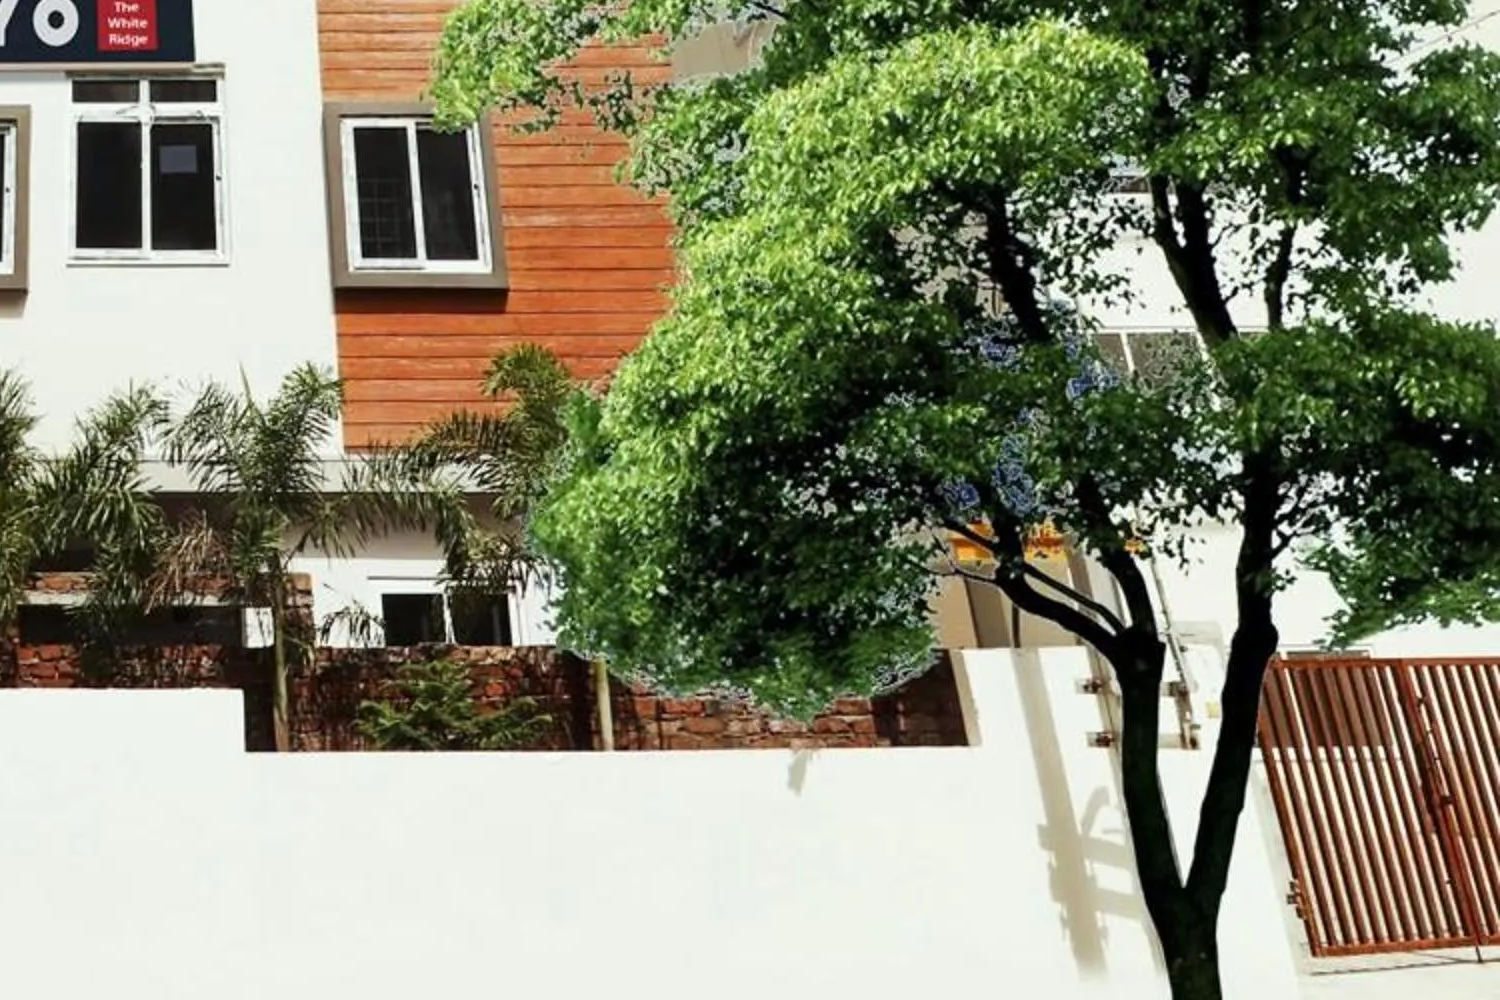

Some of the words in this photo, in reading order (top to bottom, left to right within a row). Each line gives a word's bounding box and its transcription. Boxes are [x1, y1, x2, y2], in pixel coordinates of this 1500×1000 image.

[114, 1, 140, 13] The
[107, 17, 149, 29] White
[109, 33, 149, 47] Ridge
